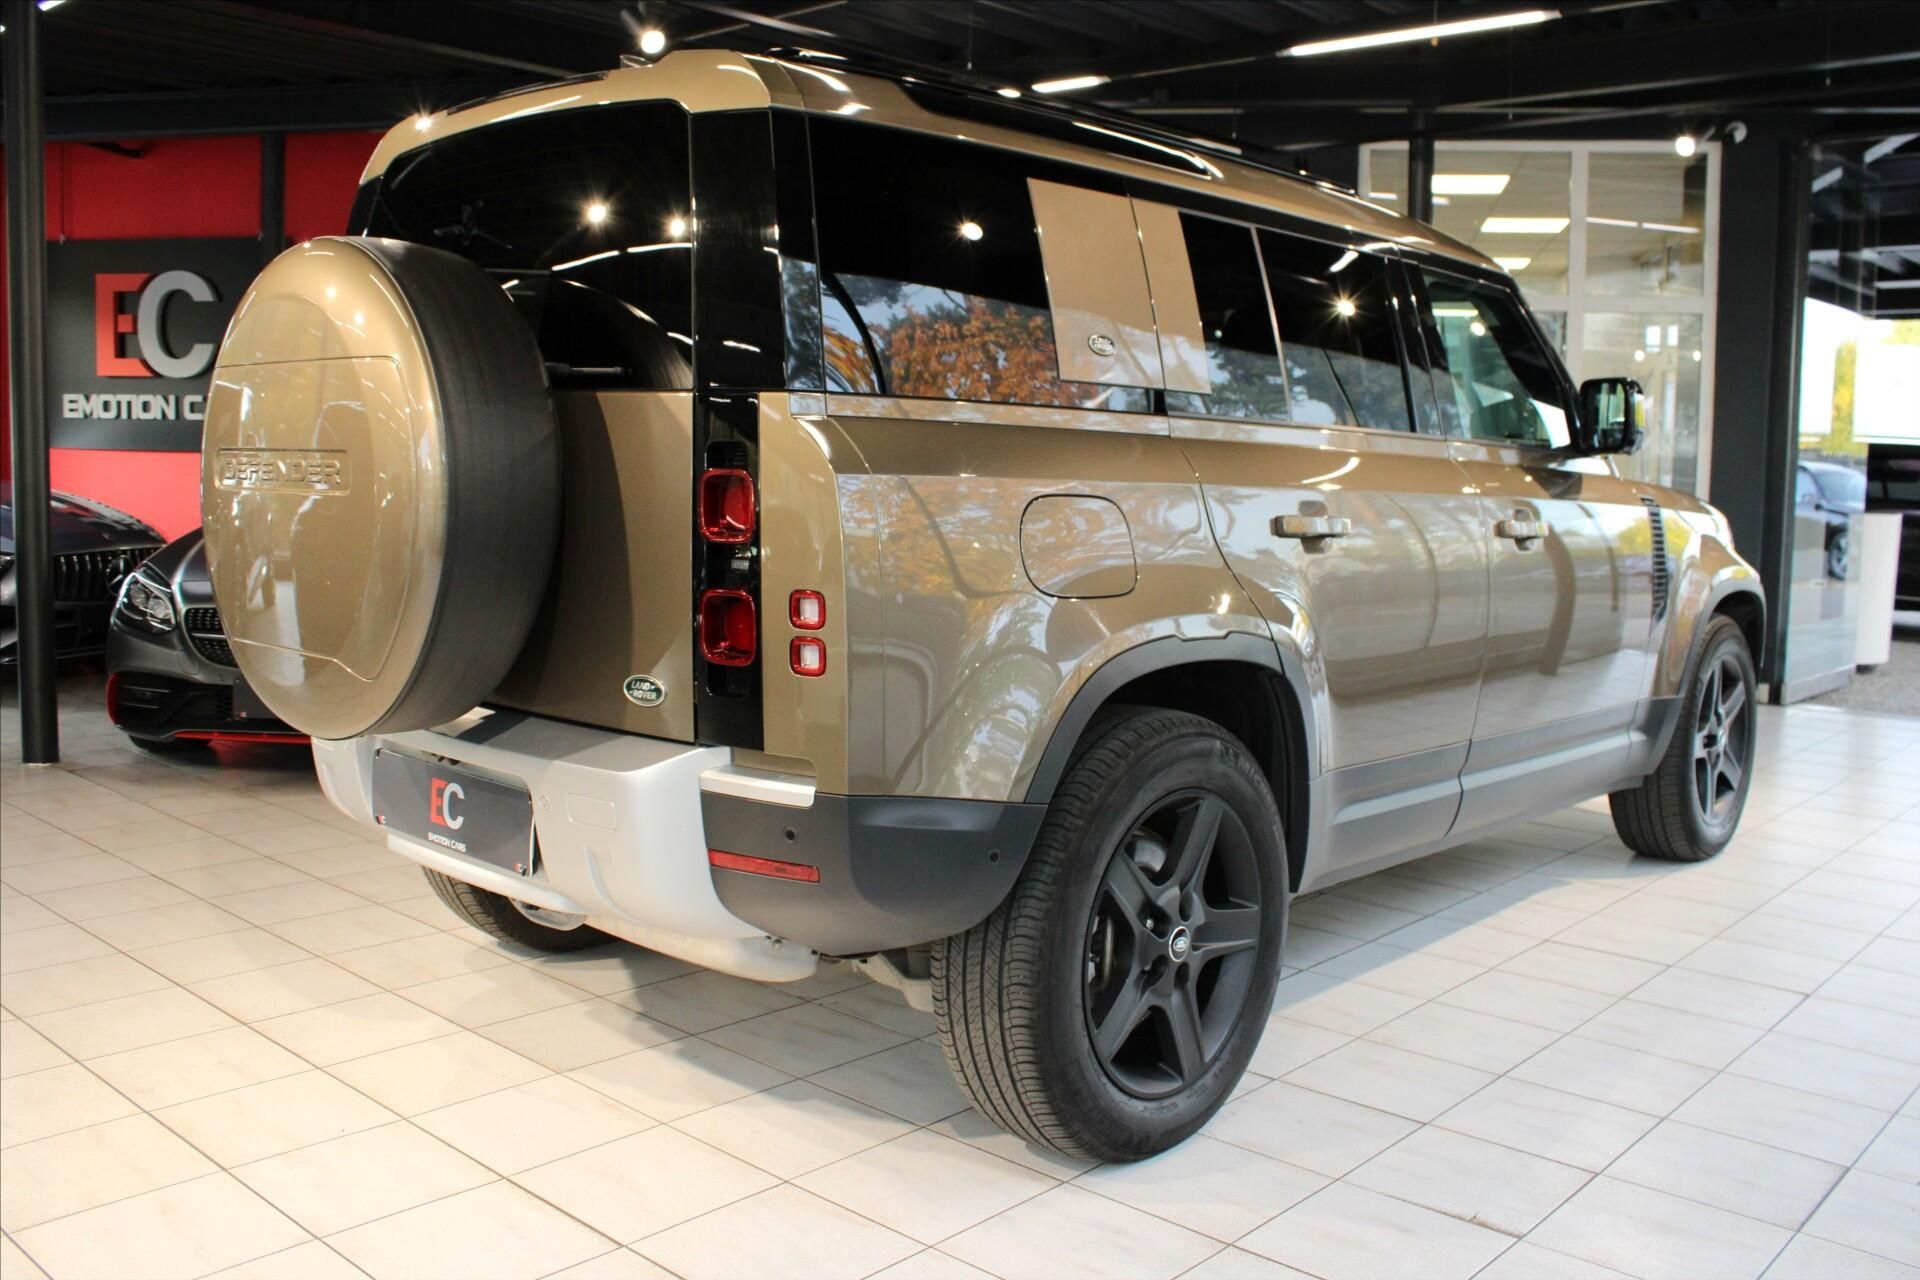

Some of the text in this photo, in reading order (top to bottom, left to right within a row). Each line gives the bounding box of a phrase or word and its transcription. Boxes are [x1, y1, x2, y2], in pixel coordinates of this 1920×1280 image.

[95, 270, 217, 378] EC
[62, 393, 176, 420] EMOTION
[222, 459, 341, 484] DEFENDER
[631, 681, 651, 691] LAND
[632, 690, 657, 700] ROVER
[431, 777, 465, 830] EC
